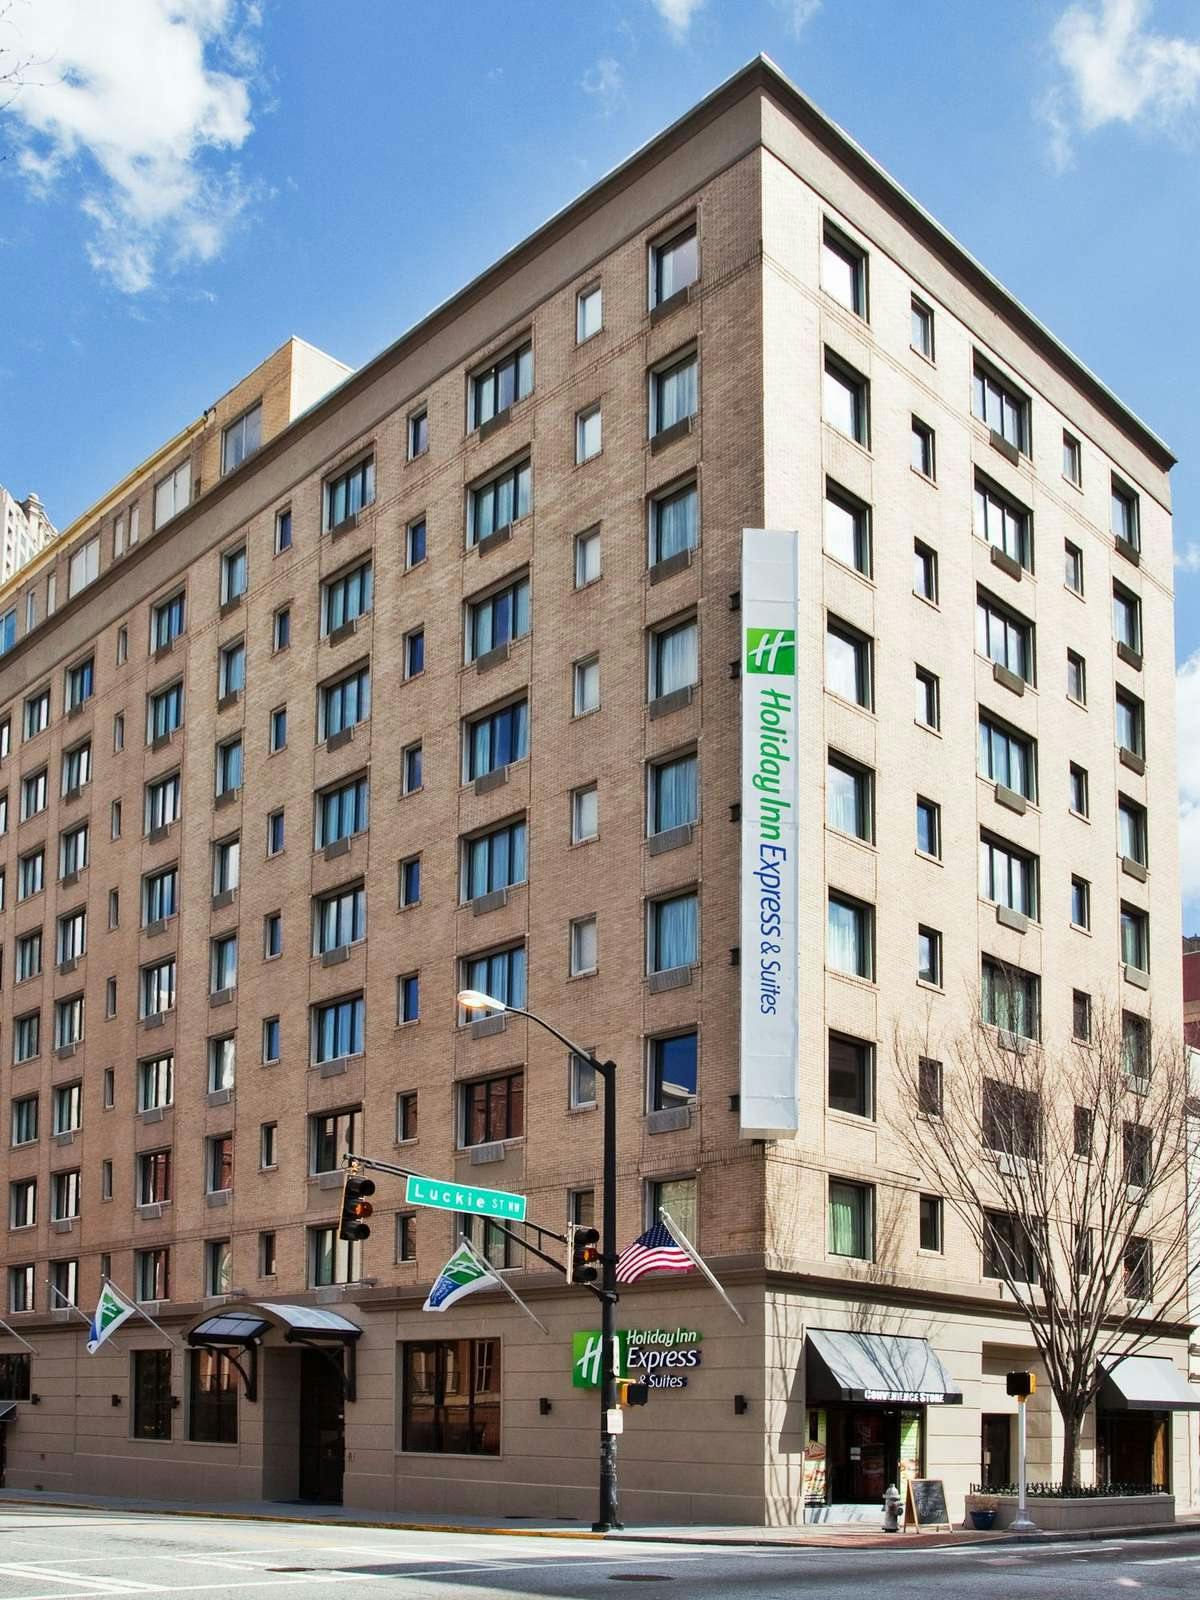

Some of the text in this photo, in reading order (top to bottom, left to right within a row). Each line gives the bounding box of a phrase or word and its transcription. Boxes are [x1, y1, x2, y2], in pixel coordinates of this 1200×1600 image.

[752, 688, 791, 1015] Holiday Inn Express & Suites
[414, 1183, 486, 1209] Luckie
[492, 1198, 504, 1209] ST
[626, 1328, 697, 1347] Holiday Inn
[626, 1347, 697, 1374] Express
[648, 1374, 683, 1388] Suites
[864, 1389, 945, 1403] CONVENIENCE STORE
